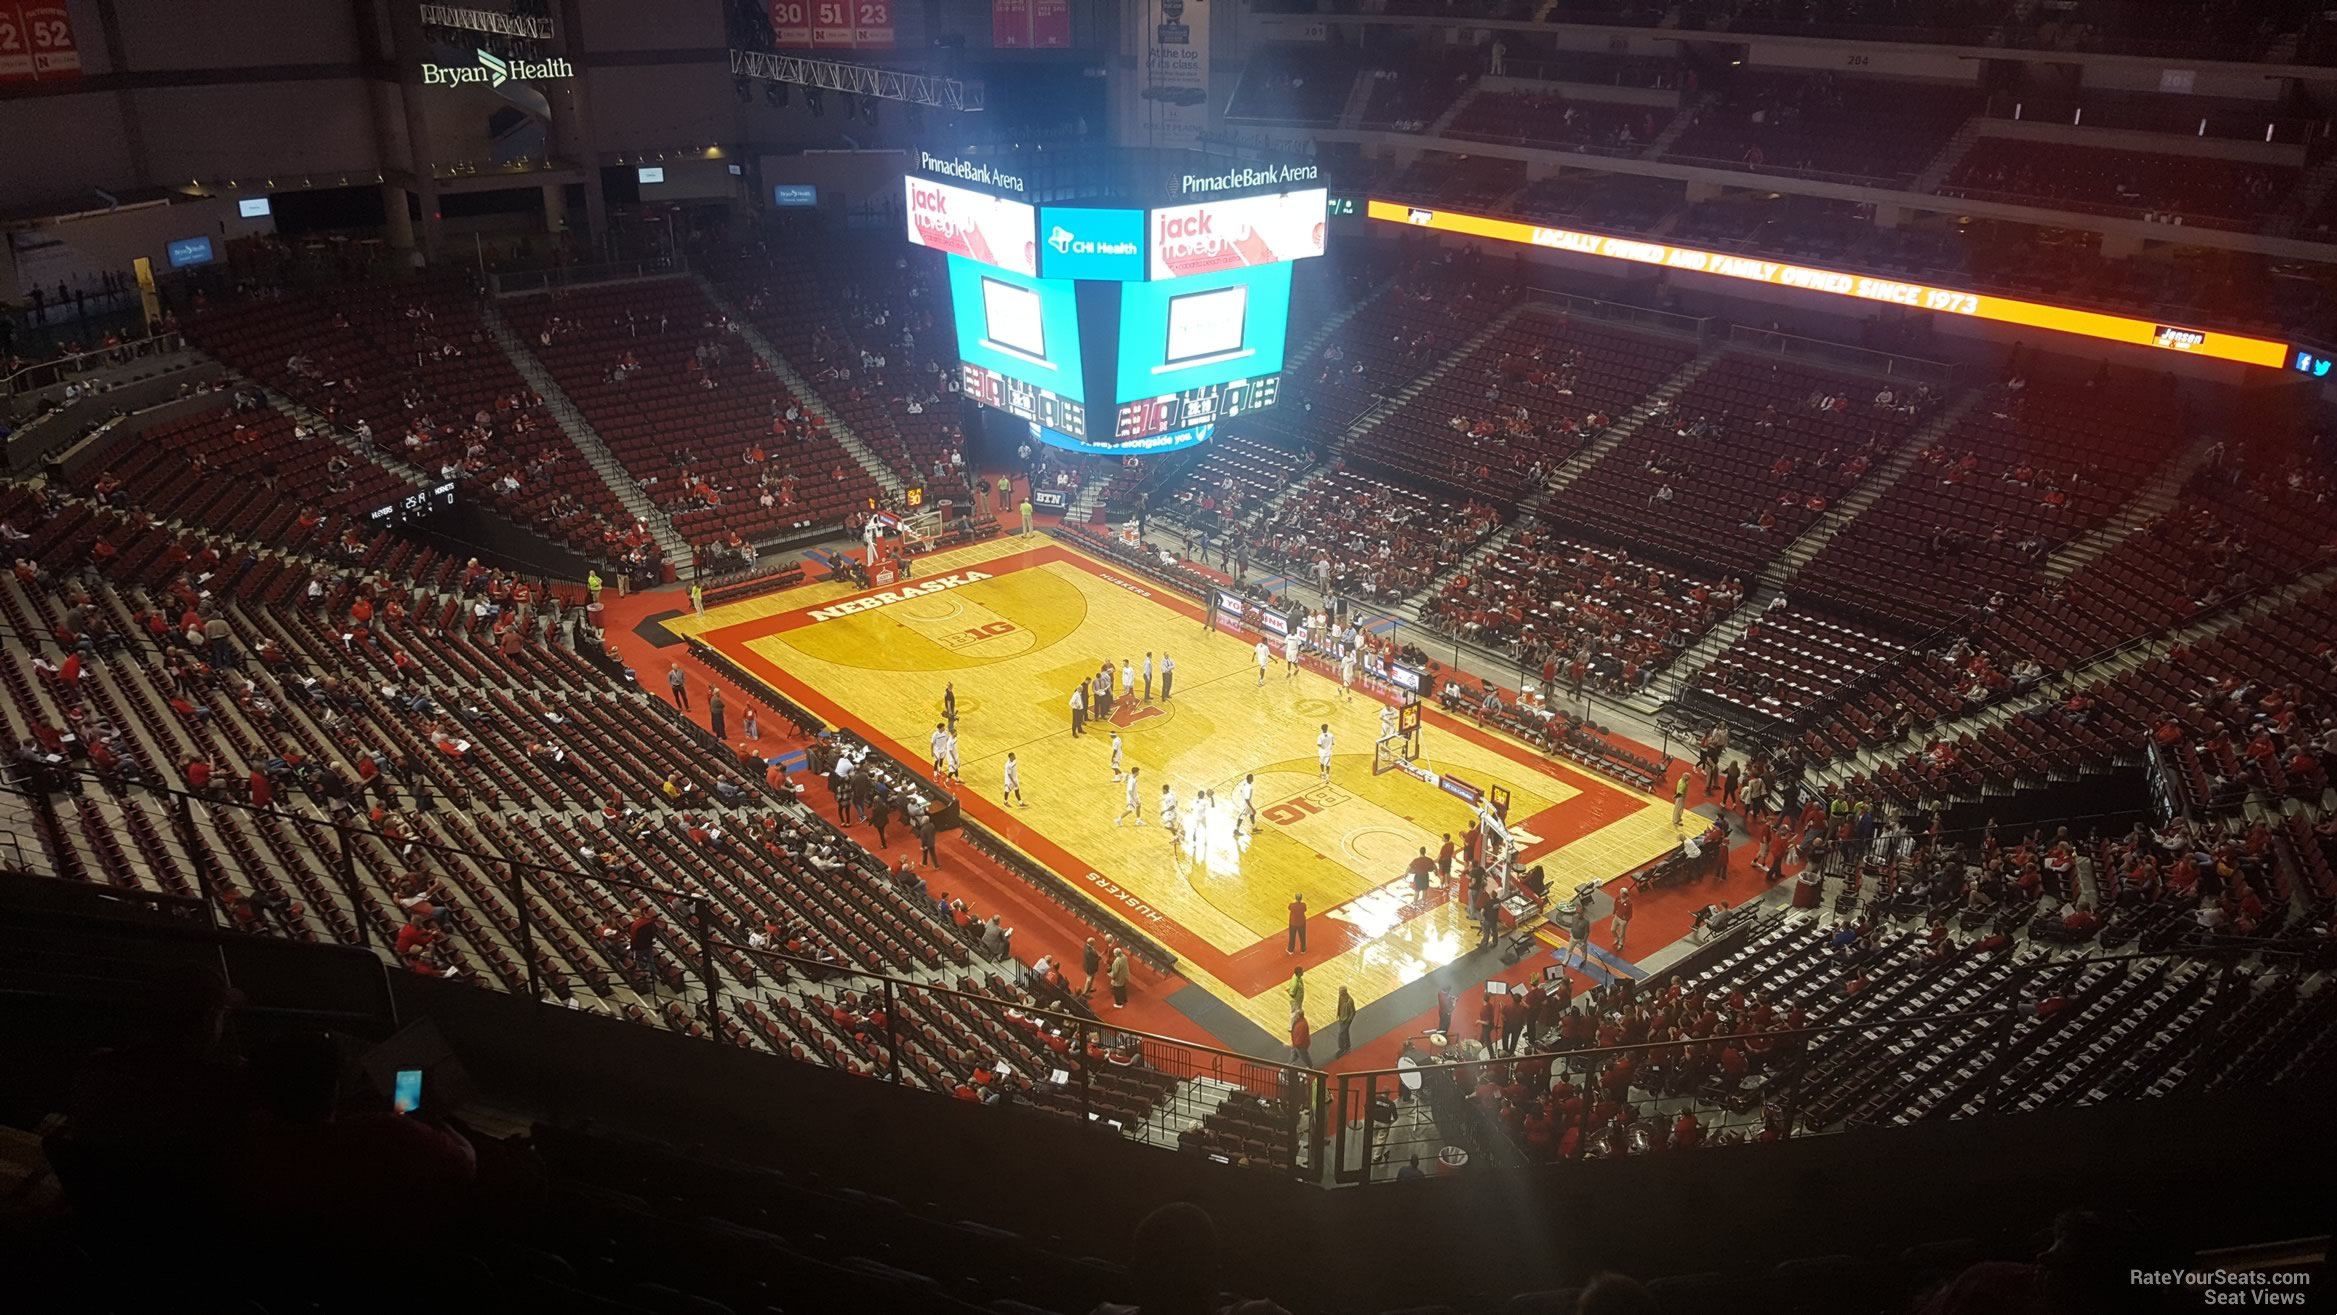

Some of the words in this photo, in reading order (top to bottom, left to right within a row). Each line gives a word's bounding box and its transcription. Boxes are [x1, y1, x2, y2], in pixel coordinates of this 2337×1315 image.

[775, 3, 802, 24] 30
[820, 3, 843, 24] 51
[860, 4, 888, 24] 23
[0, 24, 20, 50] 2
[34, 21, 71, 47] 52
[815, 31, 824, 40] N
[858, 31, 867, 40] N
[38, 56, 49, 69] N
[1150, 48, 1160, 58] At
[1163, 48, 1179, 58] the
[1181, 49, 1198, 60] top
[1848, 55, 1869, 66] 204
[421, 63, 489, 88] Bryan
[509, 57, 574, 80] Health
[992, 168, 1024, 192] Arena
[1279, 164, 1318, 184] Arena
[911, 182, 946, 215] jack
[1160, 209, 1213, 246] jack
[1072, 241, 1095, 254] CHI
[1097, 241, 1138, 256] Health
[1532, 228, 1601, 251] LOCALLY
[1602, 239, 1665, 264] OWNED
[1666, 248, 1707, 272] AND
[1709, 255, 1778, 281] FAMILY
[1780, 266, 1853, 294] OWNED
[1857, 278, 1922, 305] SINCE
[1926, 290, 1979, 314] 1973
[447, 493, 454, 504] 0
[1036, 492, 1061, 504] BTN
[806, 570, 993, 622] NEBRASKA
[1099, 573, 1151, 598] HUSKERS
[1085, 872, 1163, 922] HUSKERS
